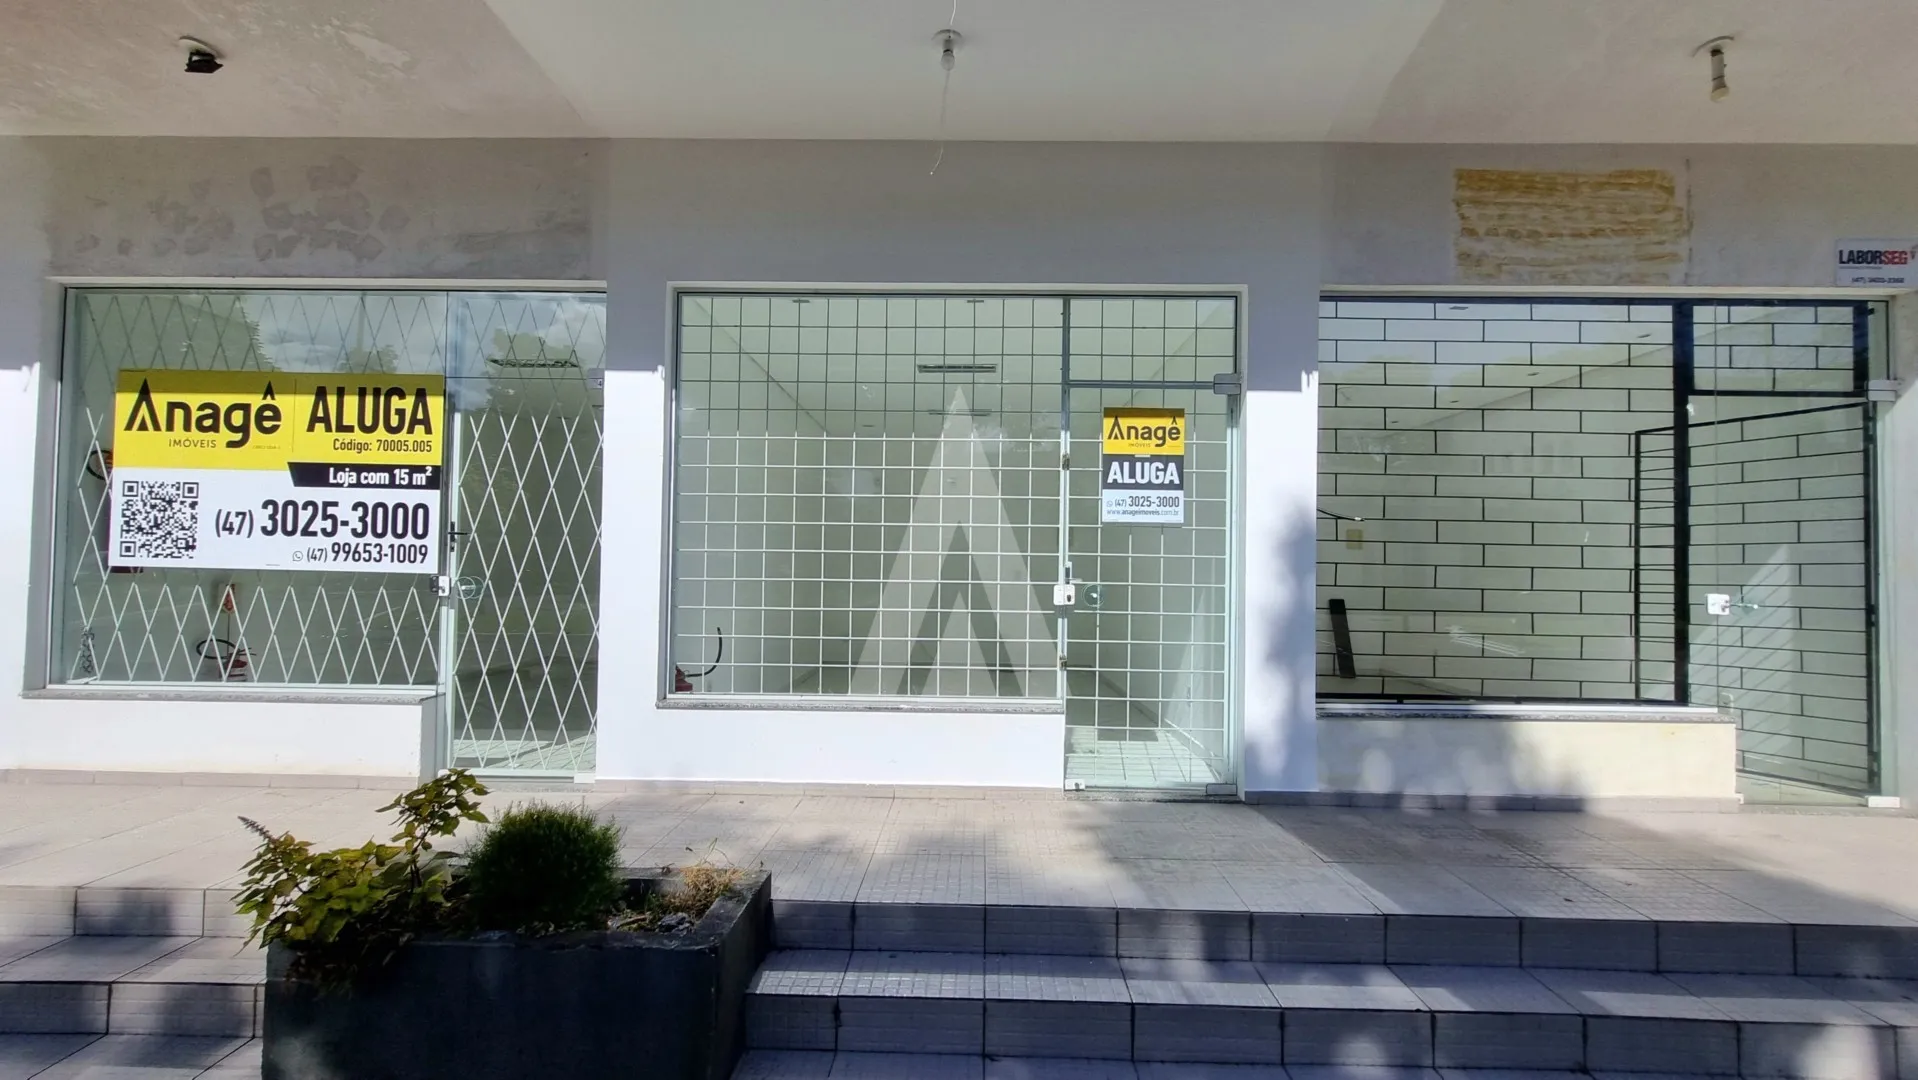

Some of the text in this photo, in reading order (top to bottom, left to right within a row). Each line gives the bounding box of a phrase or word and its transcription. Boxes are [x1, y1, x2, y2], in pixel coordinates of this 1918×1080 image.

[1838, 249, 1908, 265] LABORSEG
[306, 386, 433, 436] ALUGA
[168, 437, 217, 449] IMÓVEIS
[333, 438, 432, 454] Código: 70005.005
[329, 466, 433, 487] Loja com 15 m²
[1106, 461, 1180, 484] ALUGA
[1114, 495, 1180, 508] (47) 3025-3000
[215, 499, 429, 540] (47) 3025-3000
[1106, 508, 1179, 516] www.anageimoveis.com.br
[306, 541, 428, 564] (47) 99653-1009
